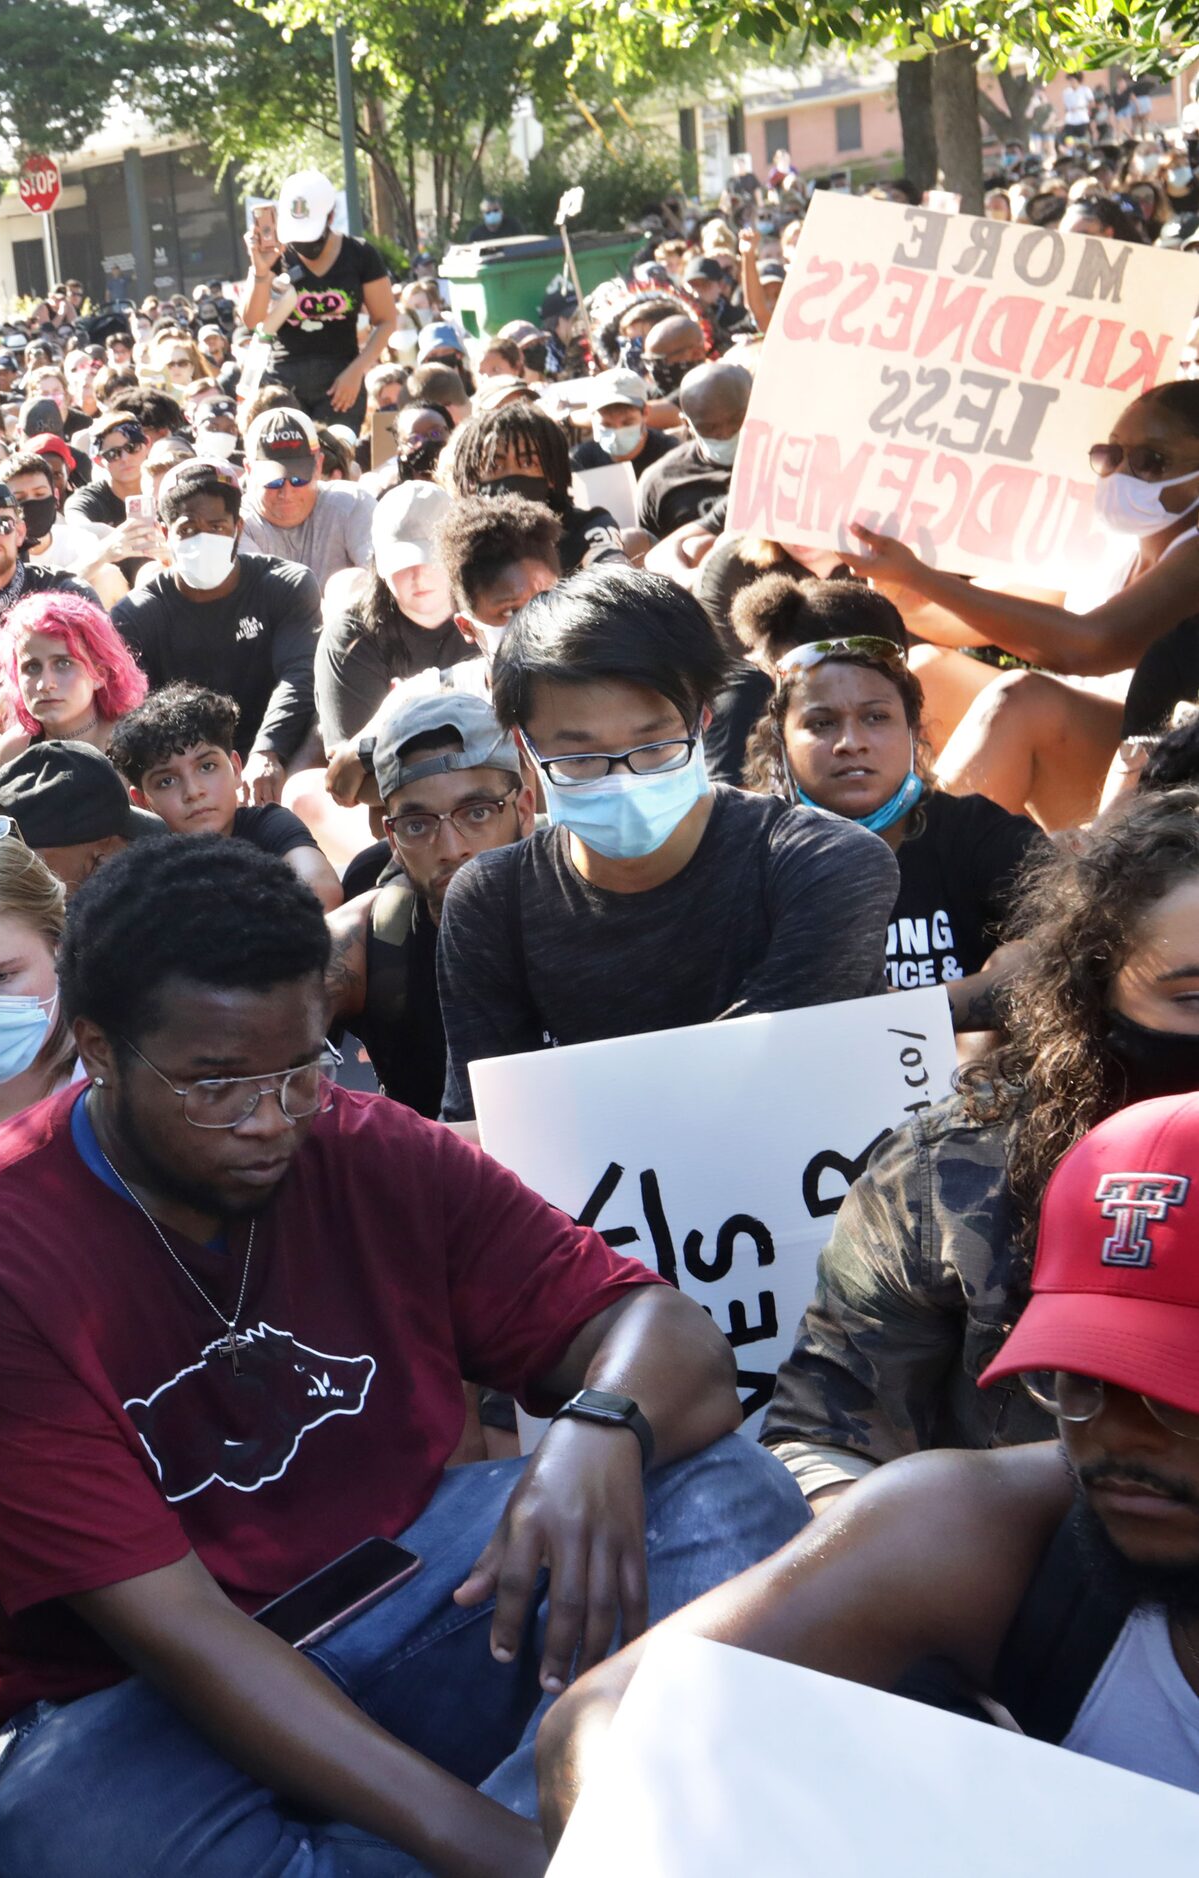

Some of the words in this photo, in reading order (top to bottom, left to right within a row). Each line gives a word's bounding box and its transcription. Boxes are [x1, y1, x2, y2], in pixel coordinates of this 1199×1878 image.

[20, 170, 57, 197] STOP
[261, 430, 304, 443] TOYOTA
[941, 955, 964, 982] &
